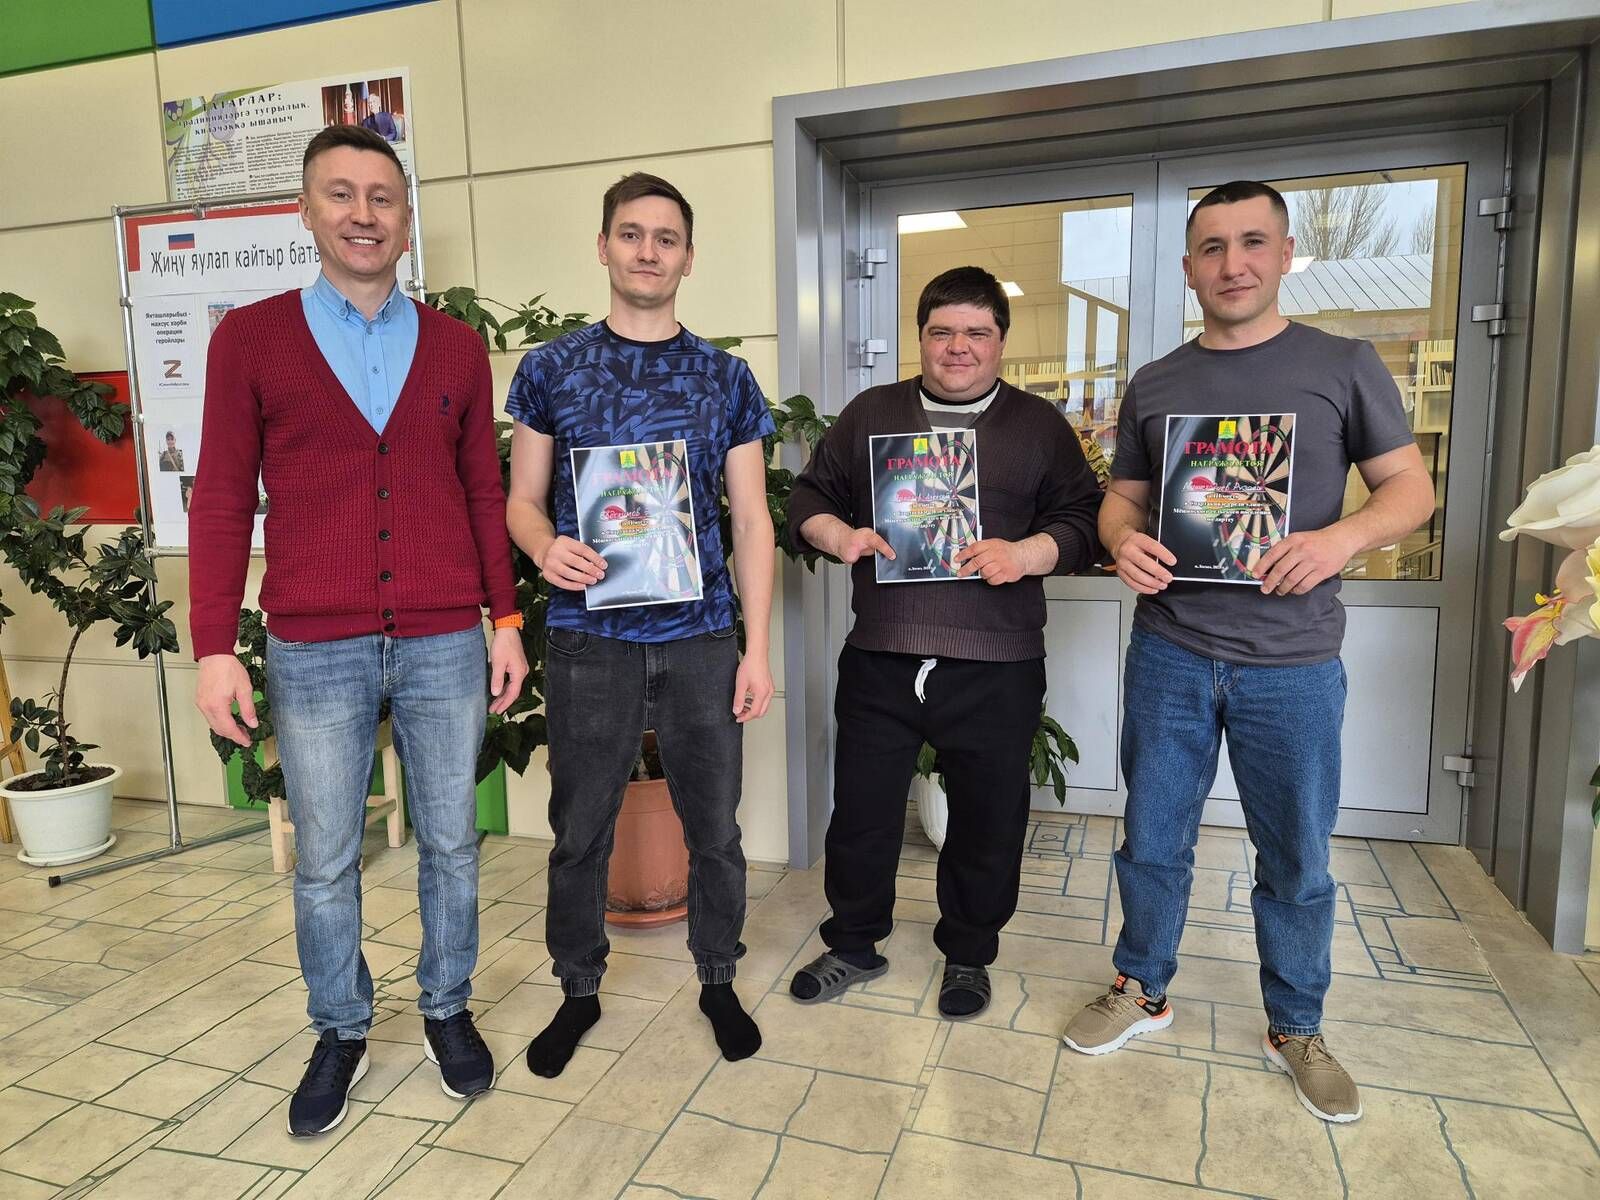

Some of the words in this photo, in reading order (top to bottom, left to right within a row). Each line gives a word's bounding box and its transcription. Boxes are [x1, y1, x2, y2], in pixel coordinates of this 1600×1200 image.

[203, 93, 282, 112] ТАТАРЛАР:
[250, 115, 293, 127] ышаныч
[151, 251, 186, 277] Җиңү
[191, 251, 230, 277] яулап
[235, 244, 284, 271] кайтыр
[163, 359, 182, 378] Z
[1184, 441, 1275, 455] ГРАМОТА
[887, 456, 961, 470] ГРАМОТА
[1190, 460, 1264, 468] НАГРАЖДАЕТСЯ
